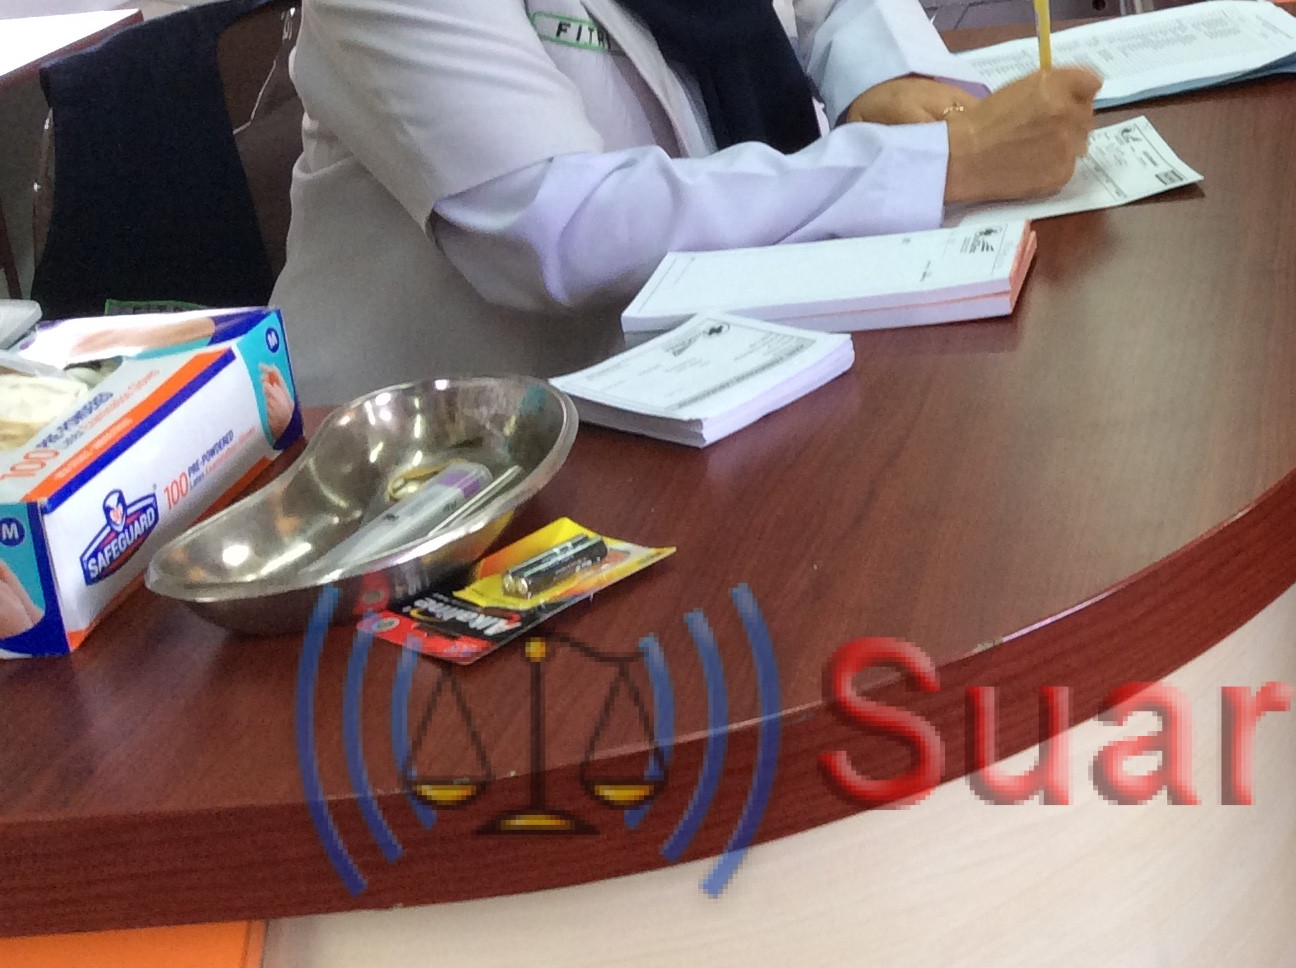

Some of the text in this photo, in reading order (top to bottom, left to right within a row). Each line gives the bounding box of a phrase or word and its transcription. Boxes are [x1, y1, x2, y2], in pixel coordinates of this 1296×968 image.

[268, 331, 278, 349] M
[164, 472, 190, 510] 100
[188, 430, 234, 478] PRE-POWDERED
[1, 522, 20, 541] M
[87, 507, 156, 579] SAFEGUARD
